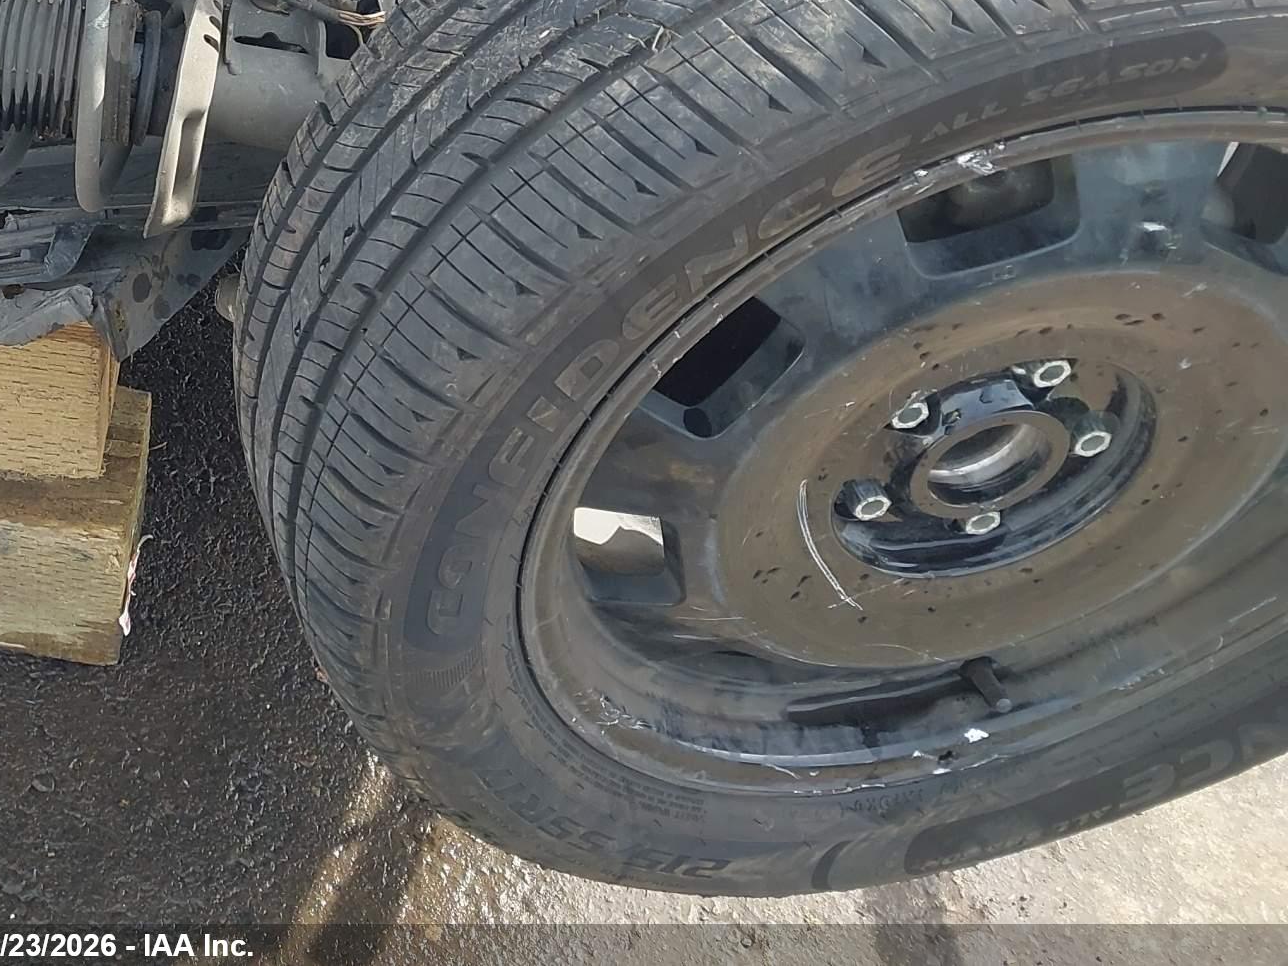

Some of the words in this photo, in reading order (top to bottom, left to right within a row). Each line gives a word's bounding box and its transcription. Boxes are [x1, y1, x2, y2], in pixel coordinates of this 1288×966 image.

[428, 151, 903, 635] CONFIDENCE
[920, 101, 1009, 145] ALL
[1021, 52, 1209, 107] SEASON
